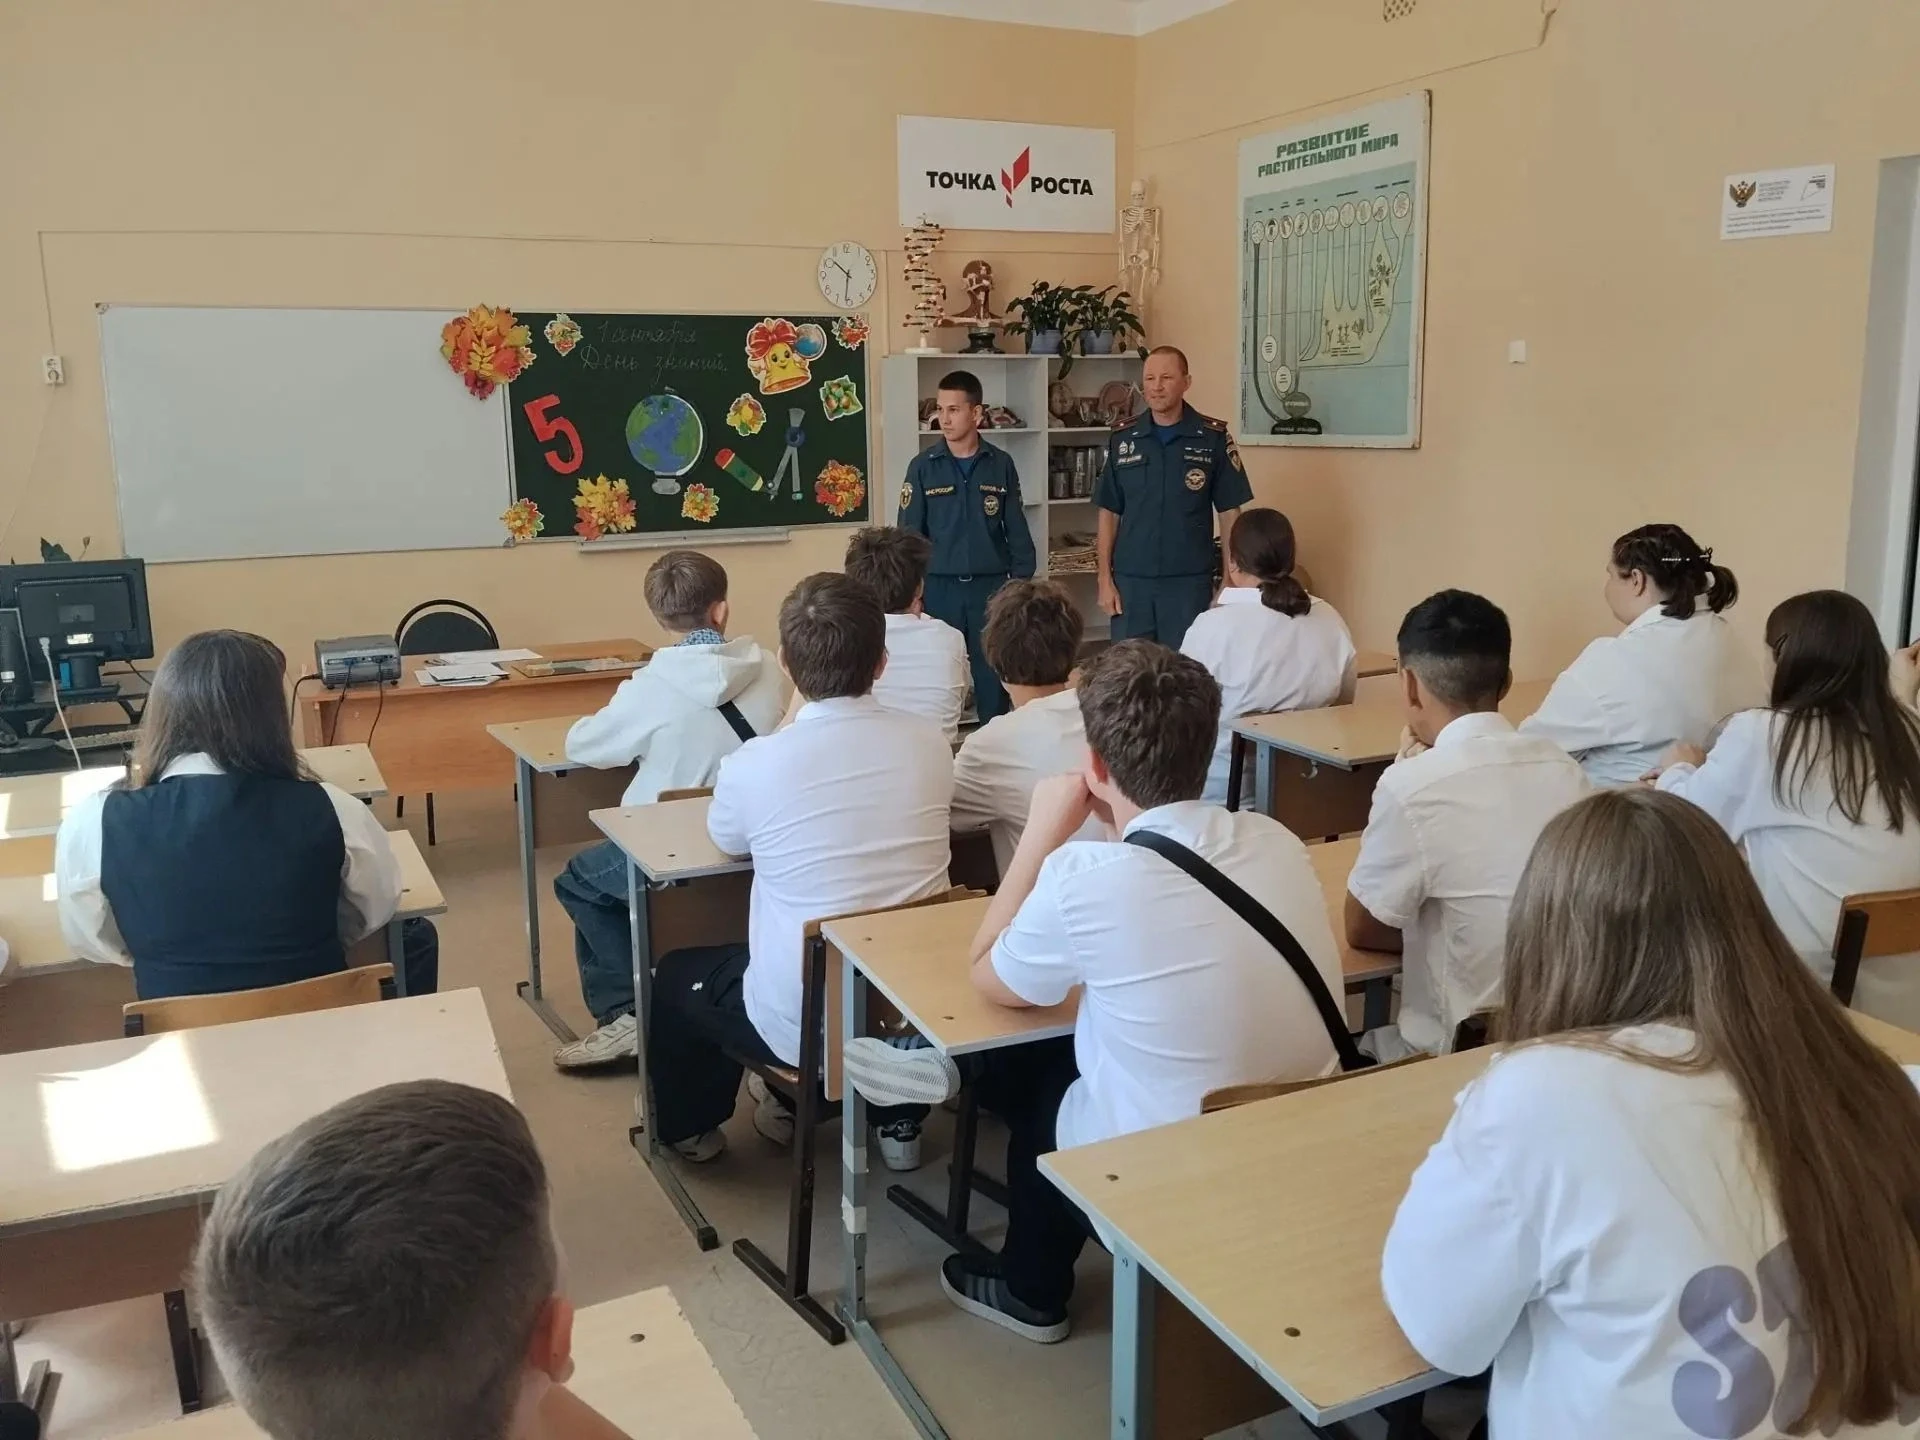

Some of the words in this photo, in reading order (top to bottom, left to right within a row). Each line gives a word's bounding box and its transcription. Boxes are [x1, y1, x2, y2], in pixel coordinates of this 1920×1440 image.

[1258, 143, 1357, 178] РАСТИТЕЛЬНОГО
[1361, 133, 1399, 154] МИРА
[1276, 123, 1370, 158] РАЗВИТИЕ
[926, 171, 996, 191] ТОЧКА
[1031, 176, 1094, 195] РОСТА
[580, 344, 640, 370] День
[523, 393, 584, 475] 5
